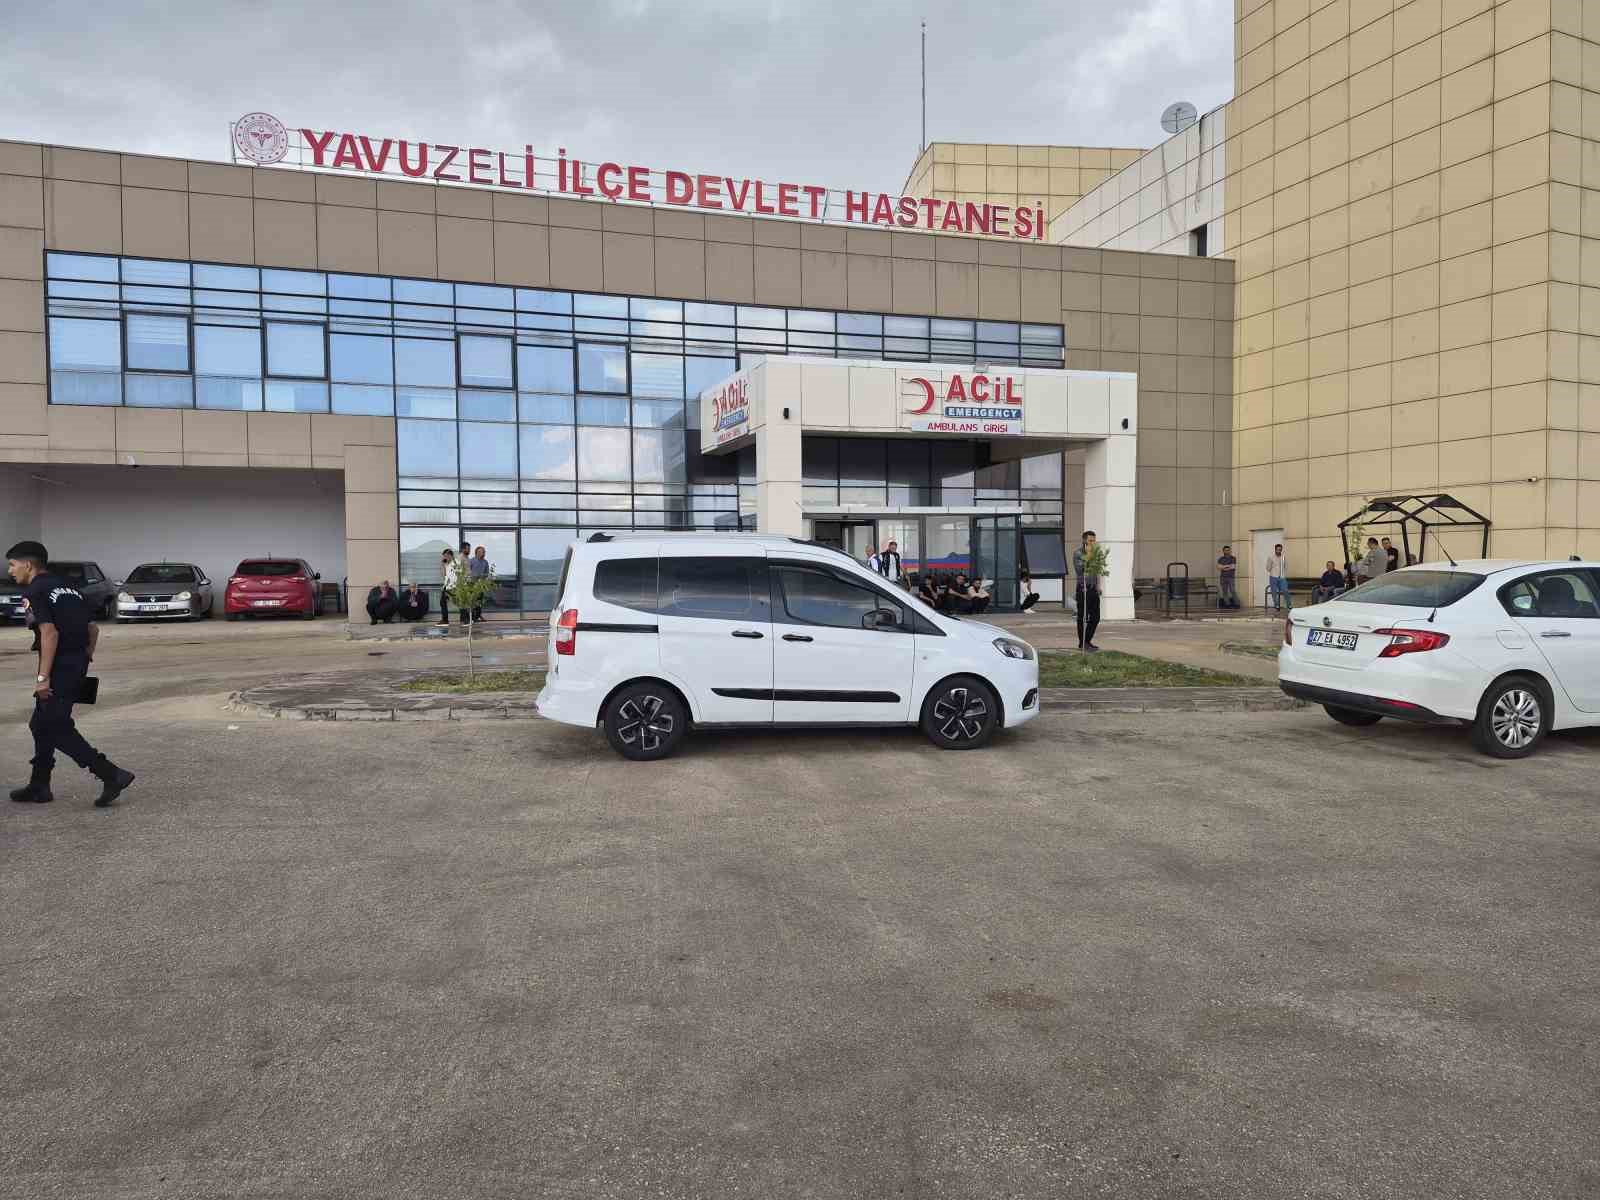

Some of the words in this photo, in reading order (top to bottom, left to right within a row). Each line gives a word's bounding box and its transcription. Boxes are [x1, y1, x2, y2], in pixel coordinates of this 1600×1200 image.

[301, 129, 535, 189] YAVUZELİ
[558, 148, 650, 203] İLÇE
[665, 171, 825, 218] DEVLET
[846, 190, 1045, 241] HASTANESİ
[948, 407, 1018, 417] EMERGENCY
[927, 422, 978, 432] AMBULANS
[1312, 631, 1322, 642] 27
[1337, 635, 1355, 647] 4952
